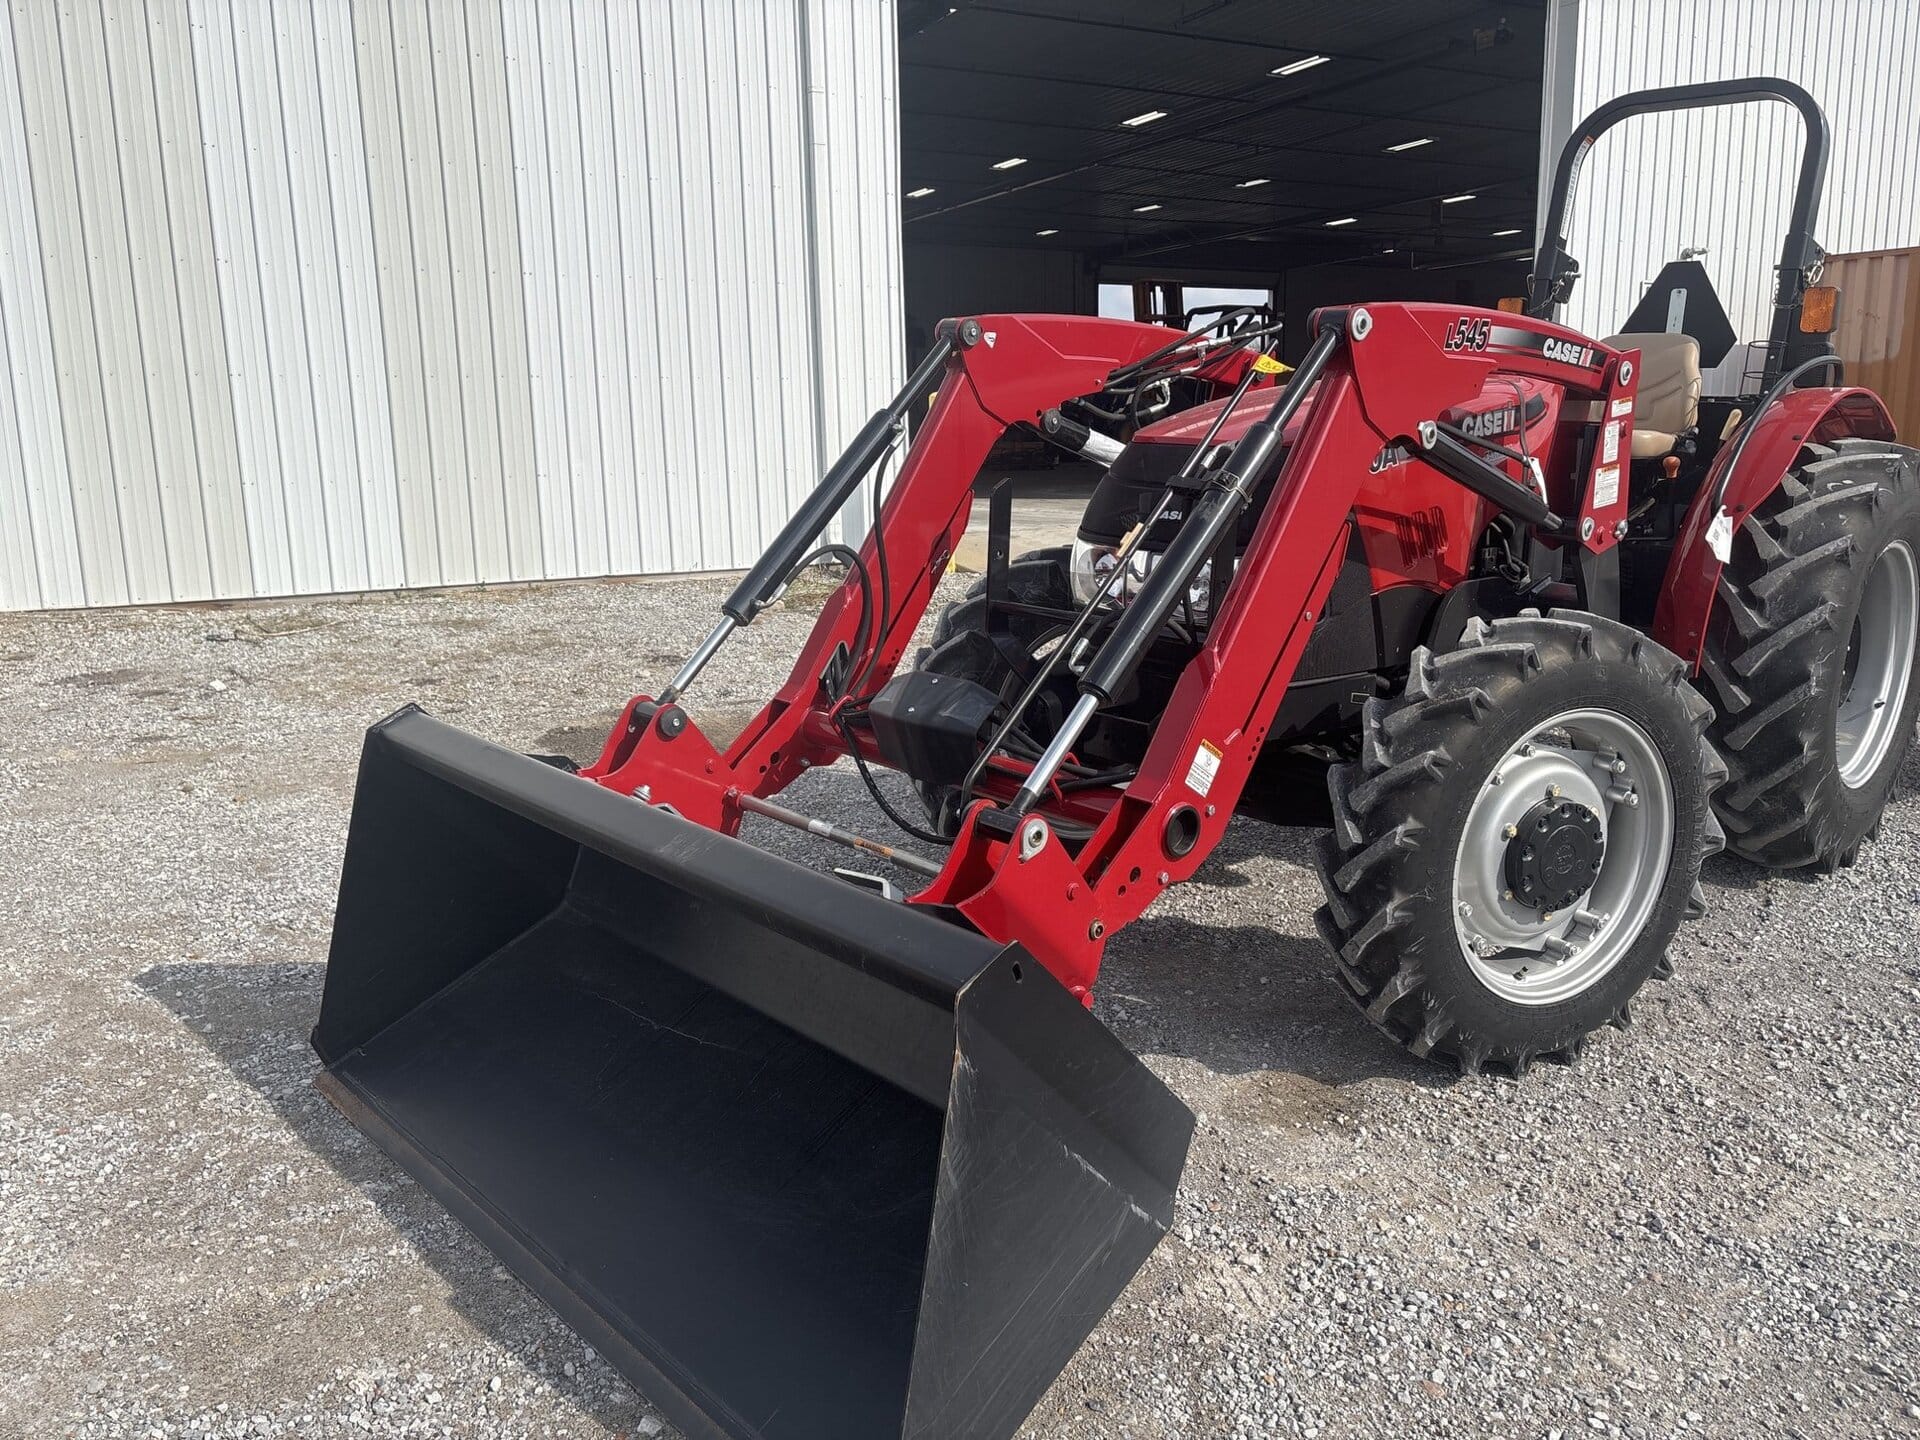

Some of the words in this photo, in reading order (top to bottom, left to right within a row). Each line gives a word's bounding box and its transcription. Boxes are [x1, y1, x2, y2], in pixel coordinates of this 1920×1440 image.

[1443, 316, 1491, 352] L545
[1542, 337, 1581, 365] CASE
[1462, 413, 1502, 437] CASE
